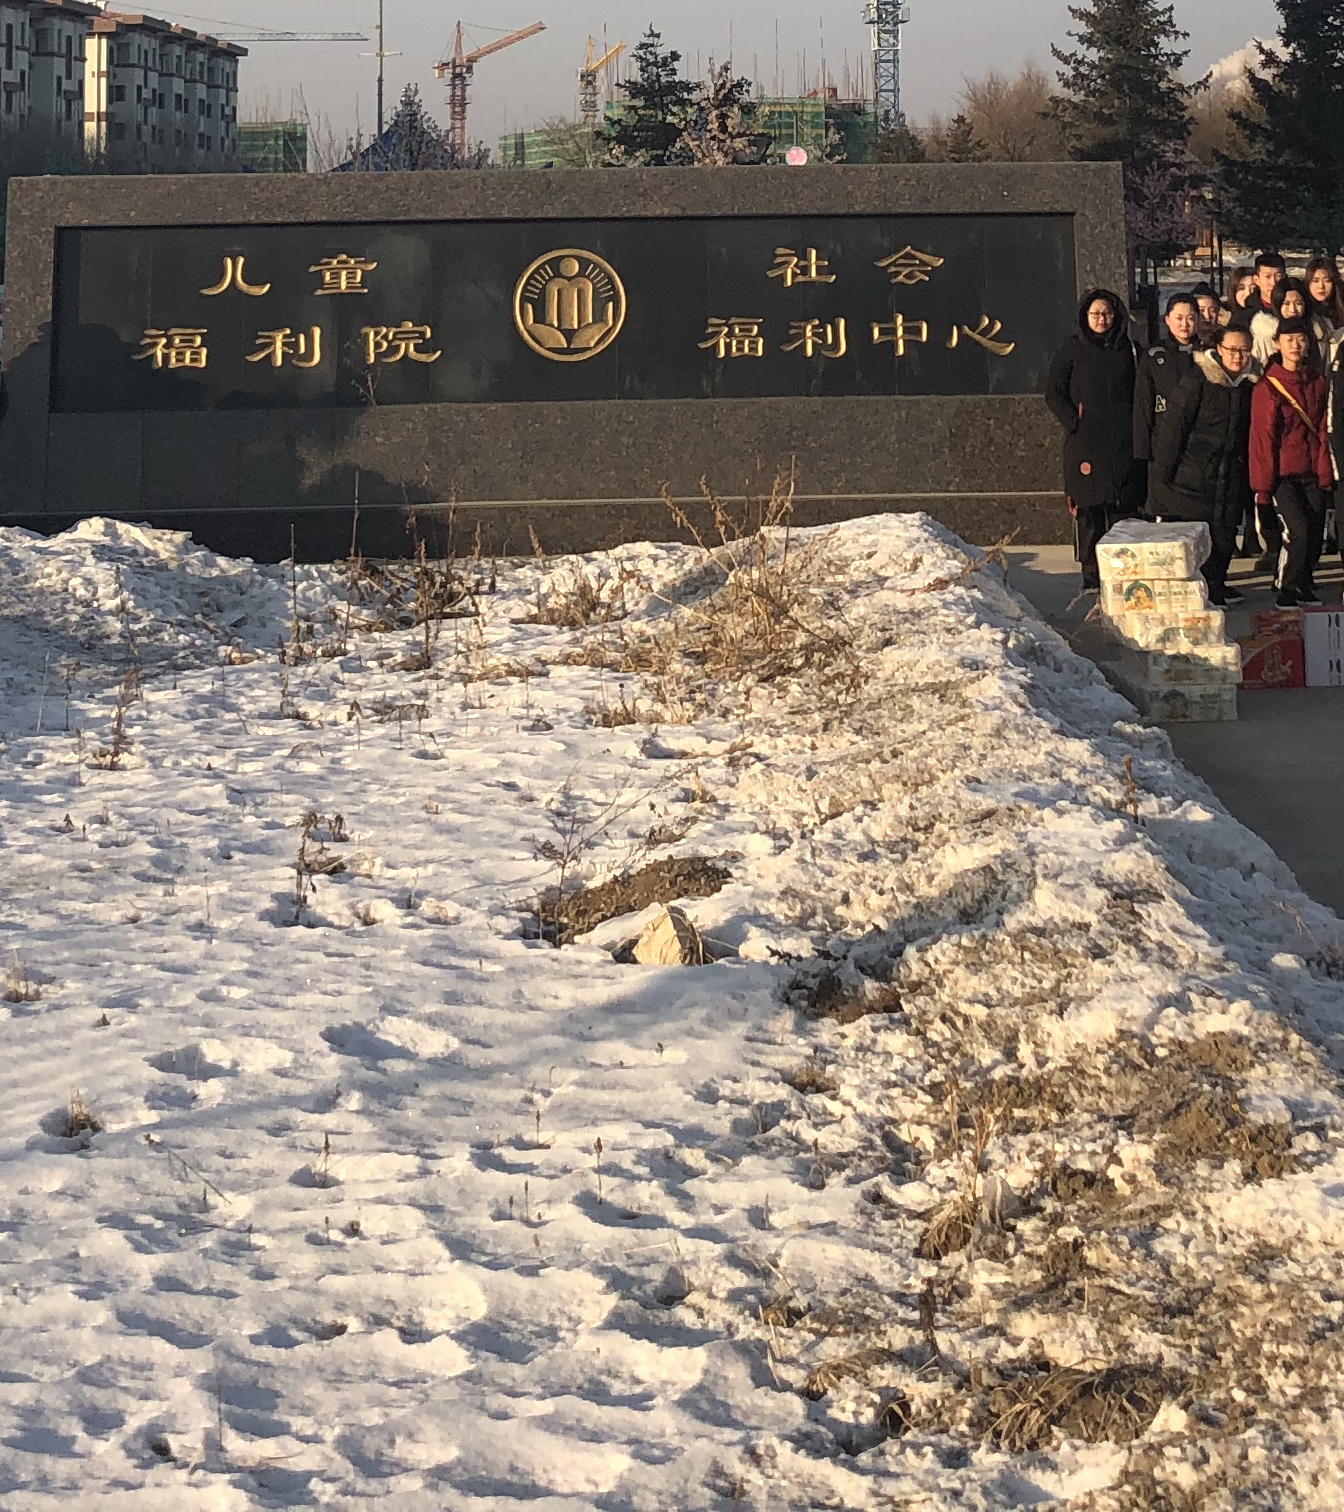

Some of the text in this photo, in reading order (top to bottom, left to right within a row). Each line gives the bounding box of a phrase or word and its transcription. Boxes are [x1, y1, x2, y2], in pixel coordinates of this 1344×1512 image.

[201, 254, 378, 296] 儿童
[766, 245, 945, 287] 社会
[131, 321, 442, 369] 福利院
[698, 313, 1015, 359] 福利中心
